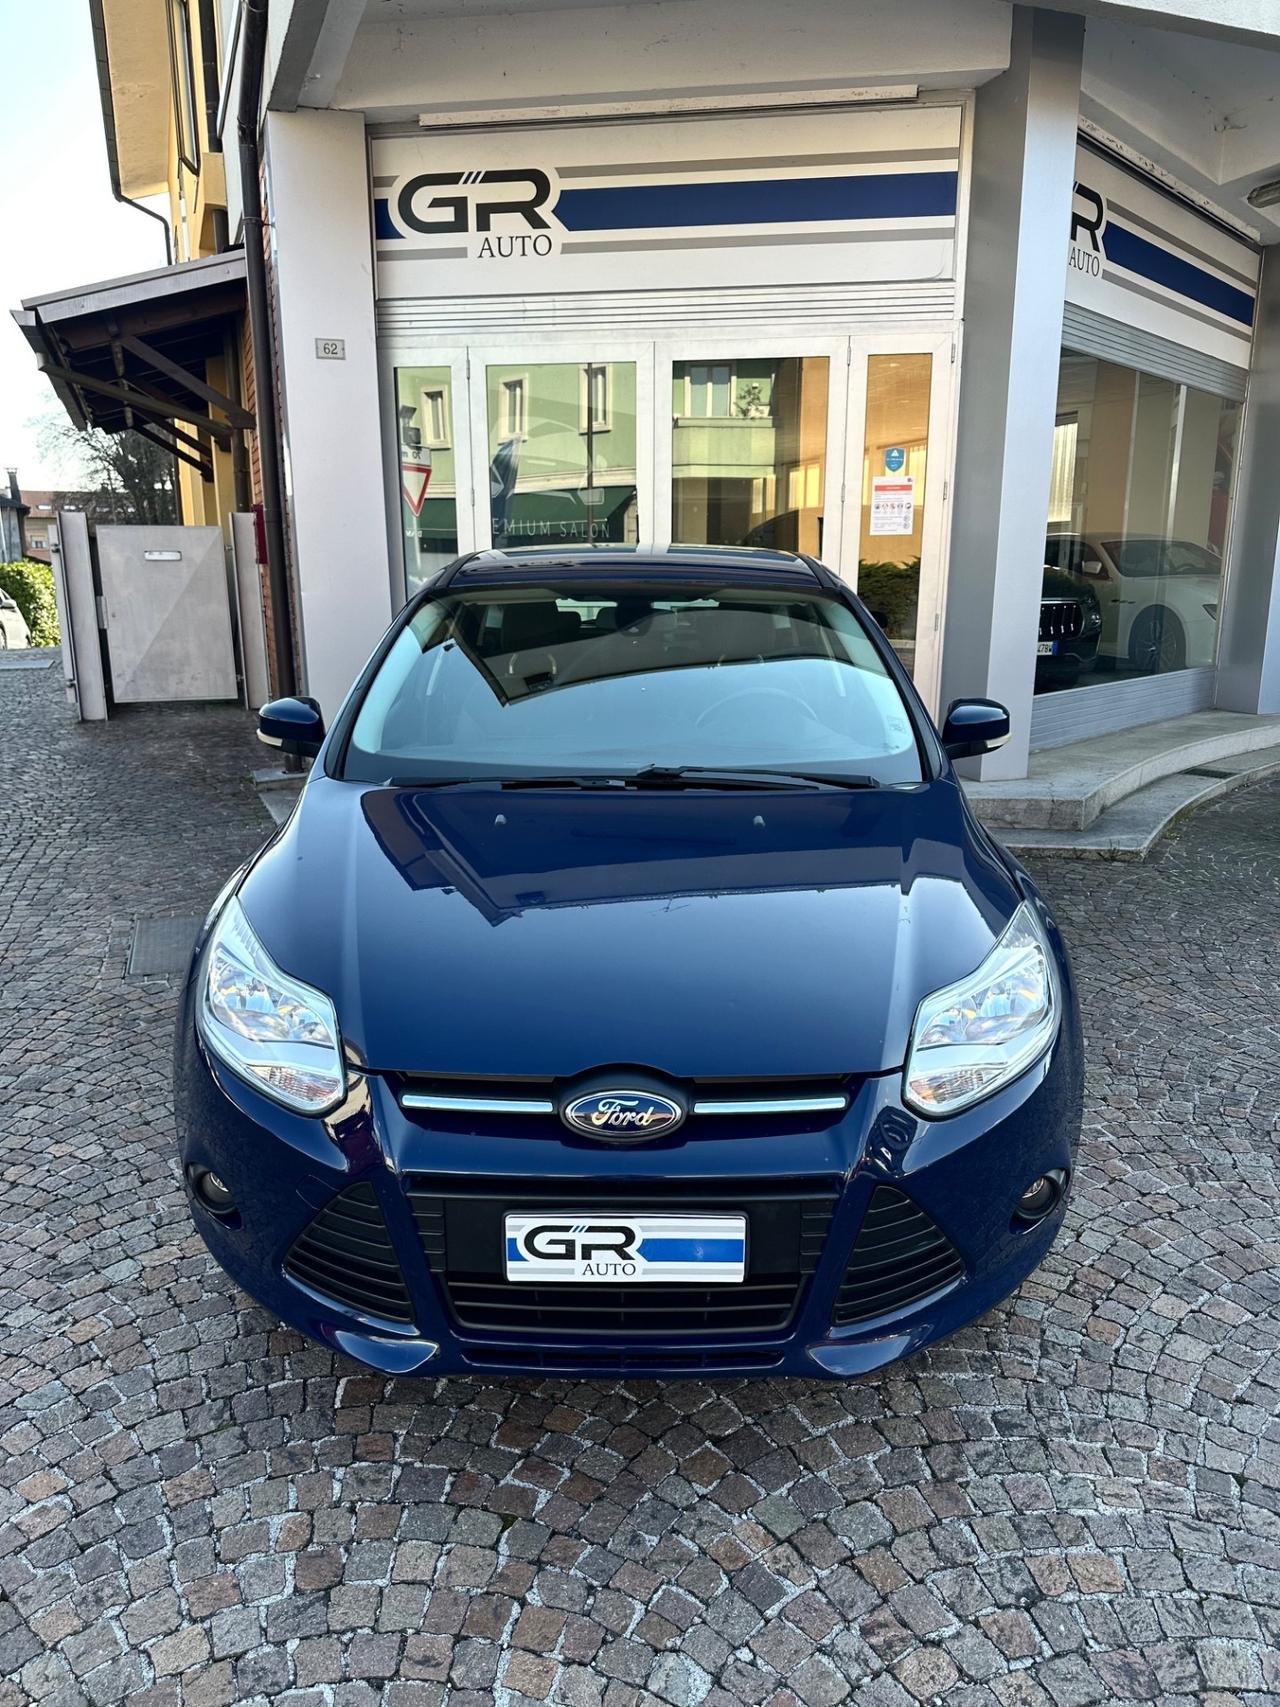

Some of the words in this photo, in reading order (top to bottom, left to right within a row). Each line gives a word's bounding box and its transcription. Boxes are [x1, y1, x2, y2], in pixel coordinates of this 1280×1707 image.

[398, 168, 552, 234] GR
[1070, 181, 1104, 253] R
[477, 234, 553, 258] AUTO
[1068, 246, 1100, 277] AUTO
[323, 342, 338, 355] 62
[492, 517, 551, 537] EMIUM
[560, 521, 610, 539] SALON
[592, 1098, 654, 1126] Ford
[523, 1225, 636, 1260] GR
[582, 1263, 636, 1276] AUTO
